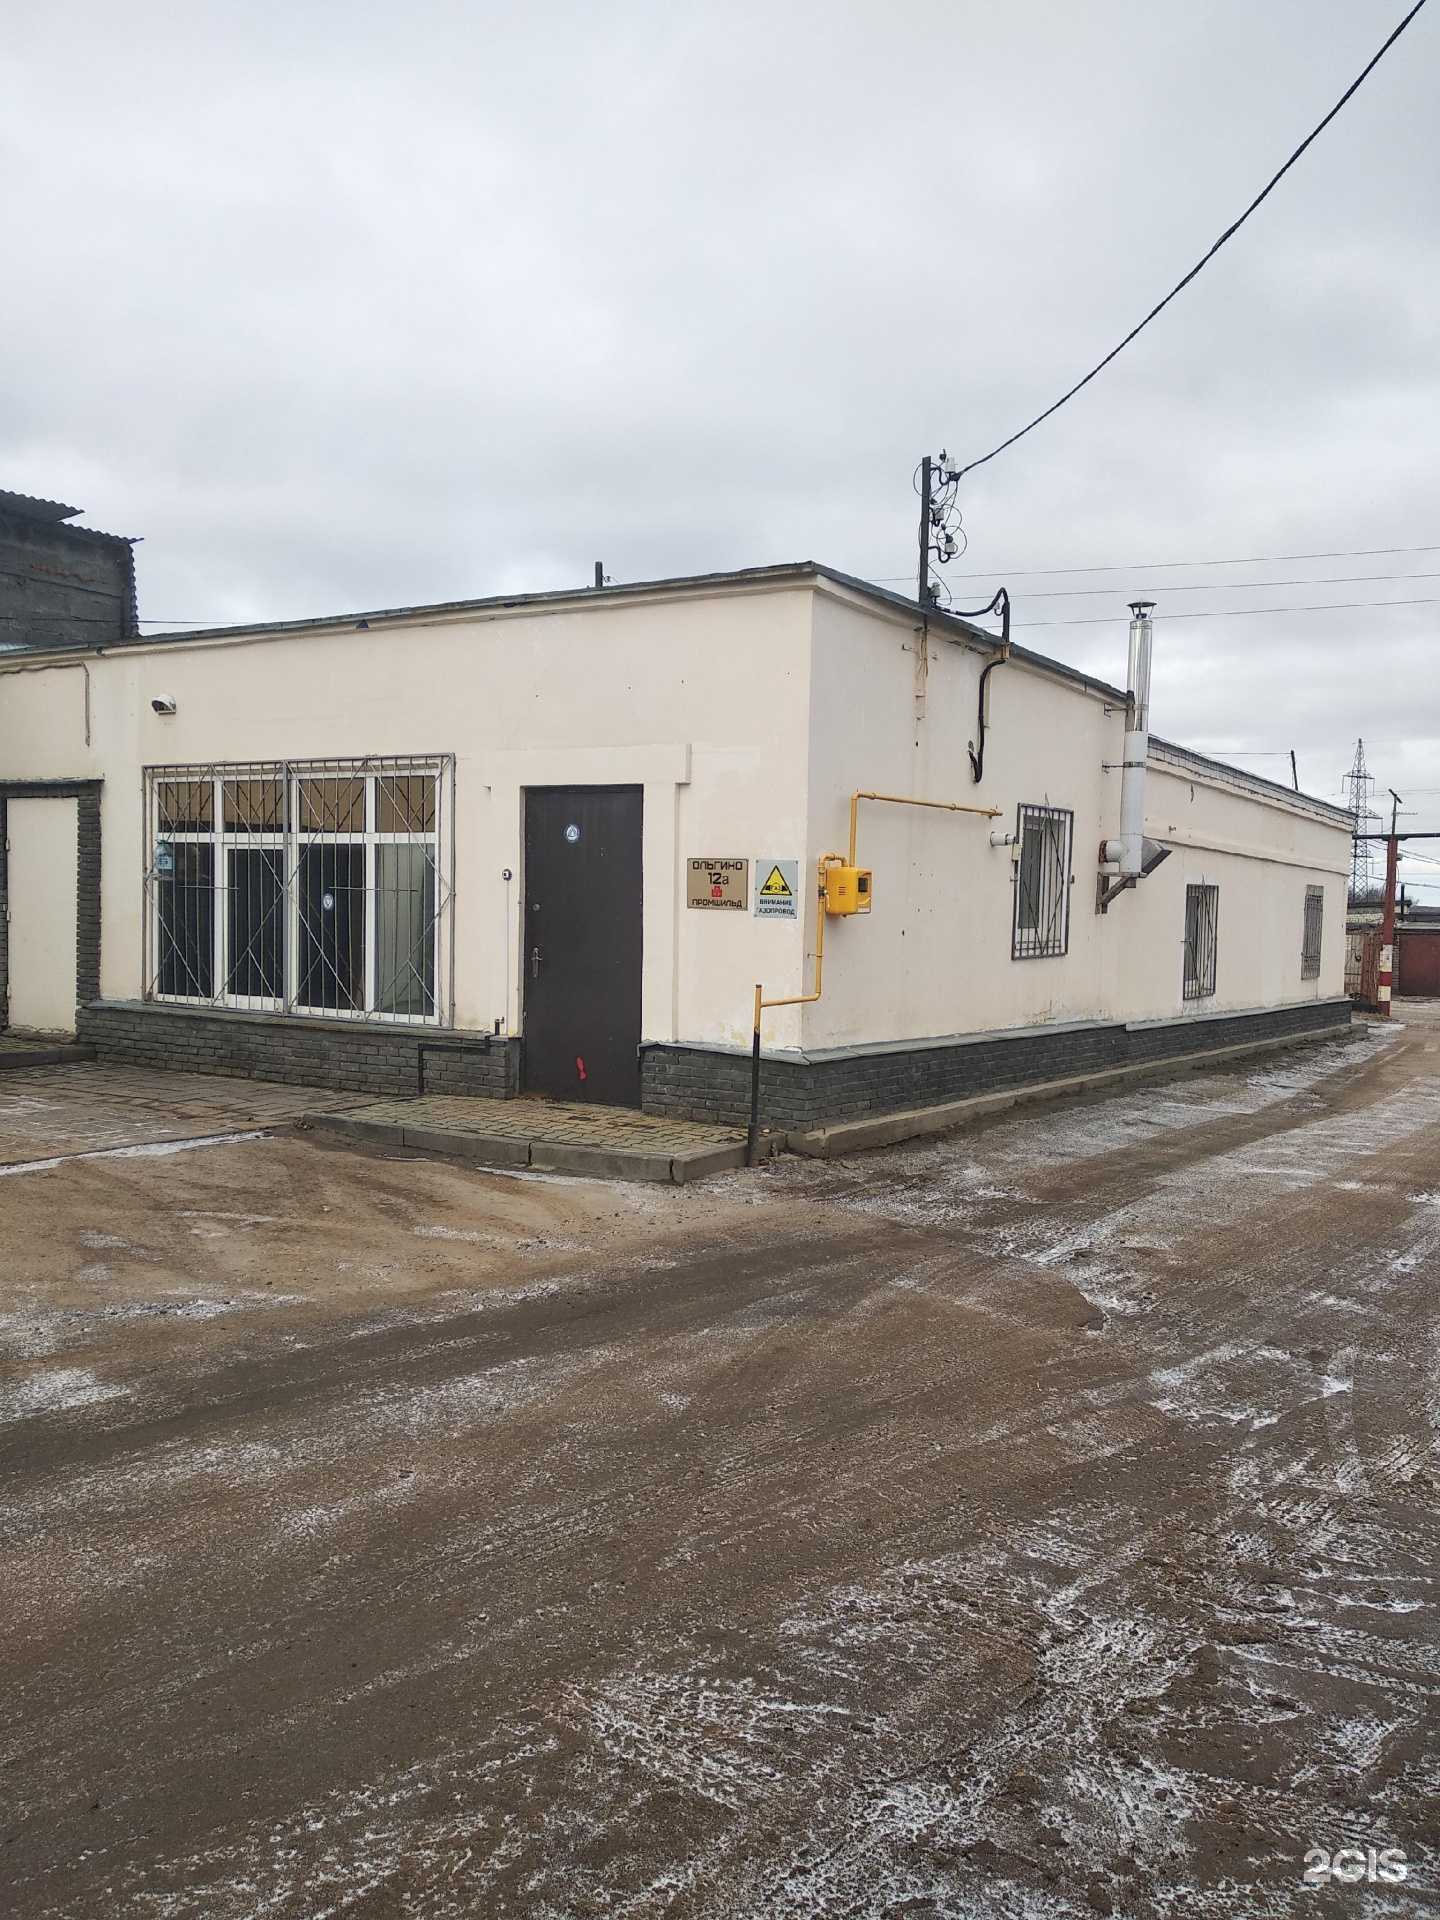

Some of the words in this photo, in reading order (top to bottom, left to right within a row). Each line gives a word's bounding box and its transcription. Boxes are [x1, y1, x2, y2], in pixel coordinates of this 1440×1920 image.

[692, 861, 743, 871] ОЛЬГИНО
[707, 872, 729, 885] 12а
[759, 898, 792, 906] ВНИМАНИЕ
[756, 907, 795, 915] АЗОПРОВОД
